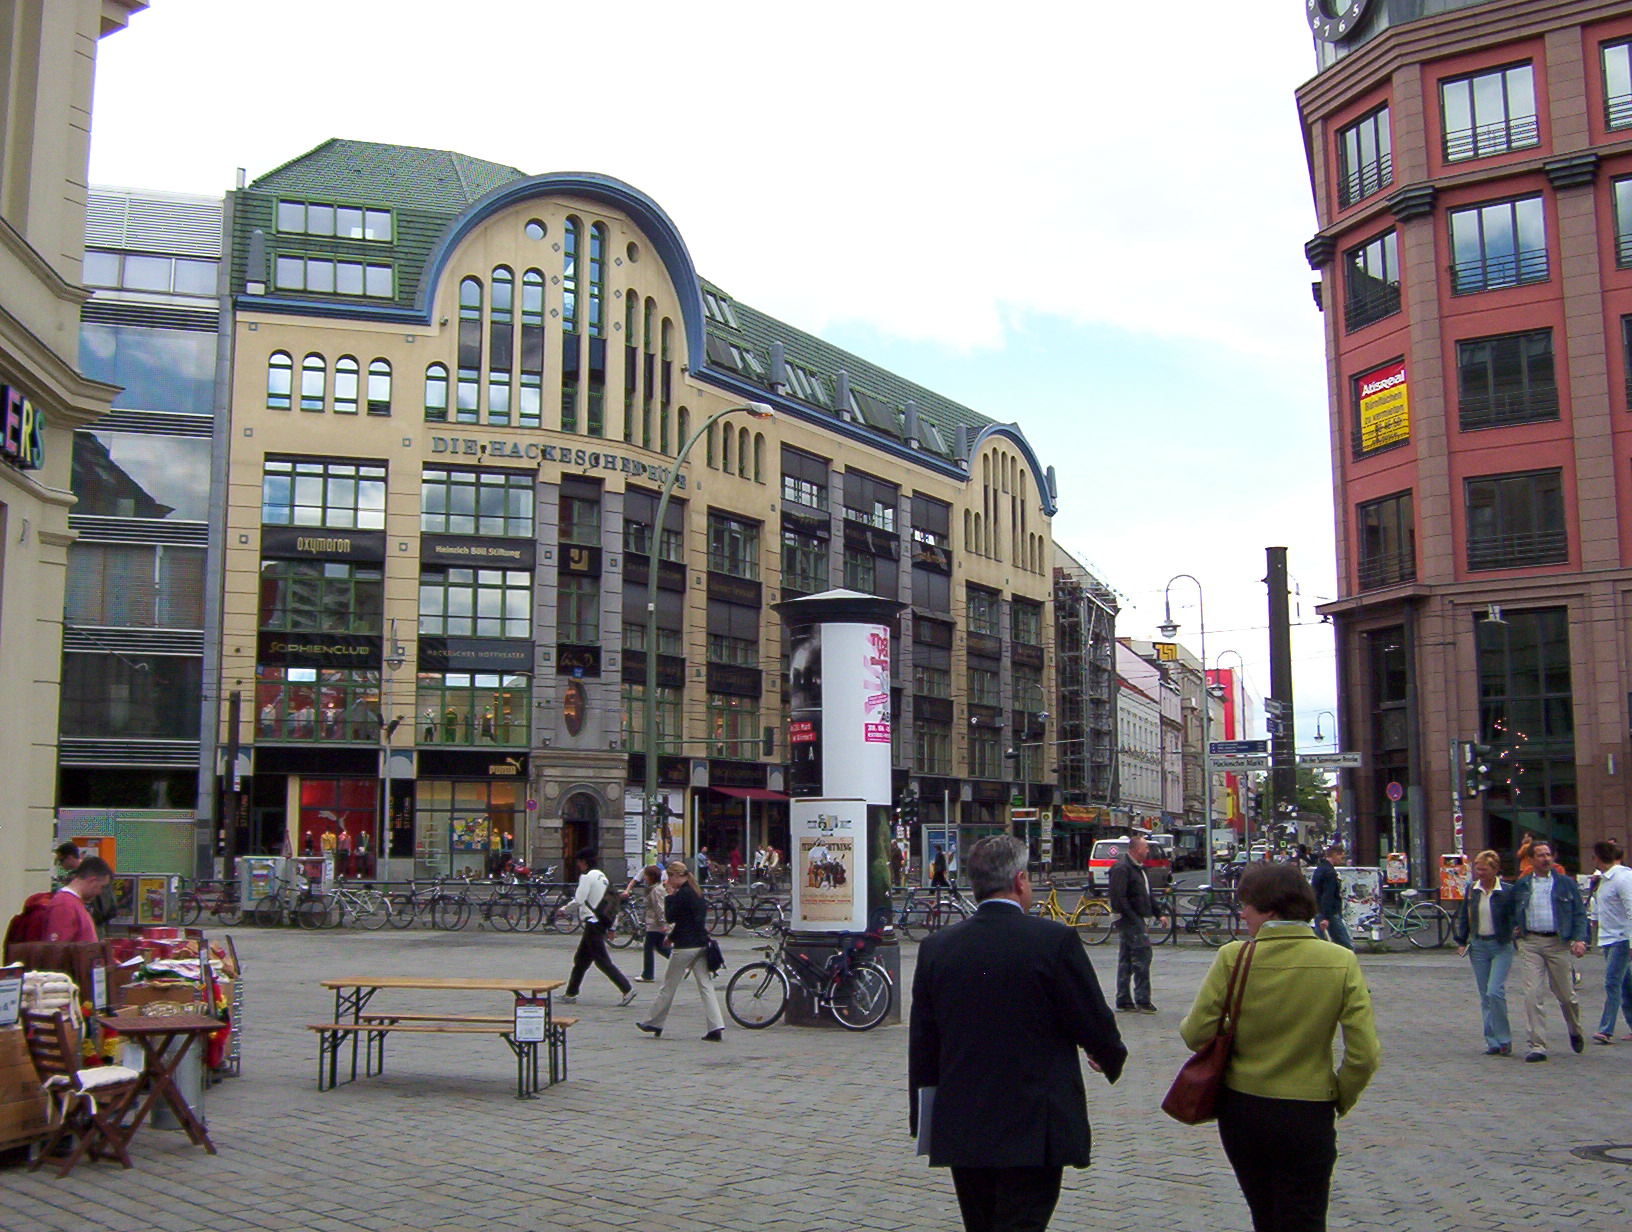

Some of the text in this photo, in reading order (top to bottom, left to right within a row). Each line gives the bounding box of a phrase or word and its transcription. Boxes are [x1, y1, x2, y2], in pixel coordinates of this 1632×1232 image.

[1352, 3, 1360, 17] 5
[1338, 19, 1346, 33] 6
[0, 385, 46, 470] ERS
[432, 436, 687, 490] DIE HACKESCHEN HÖE
[297, 537, 351, 554] oxymoron
